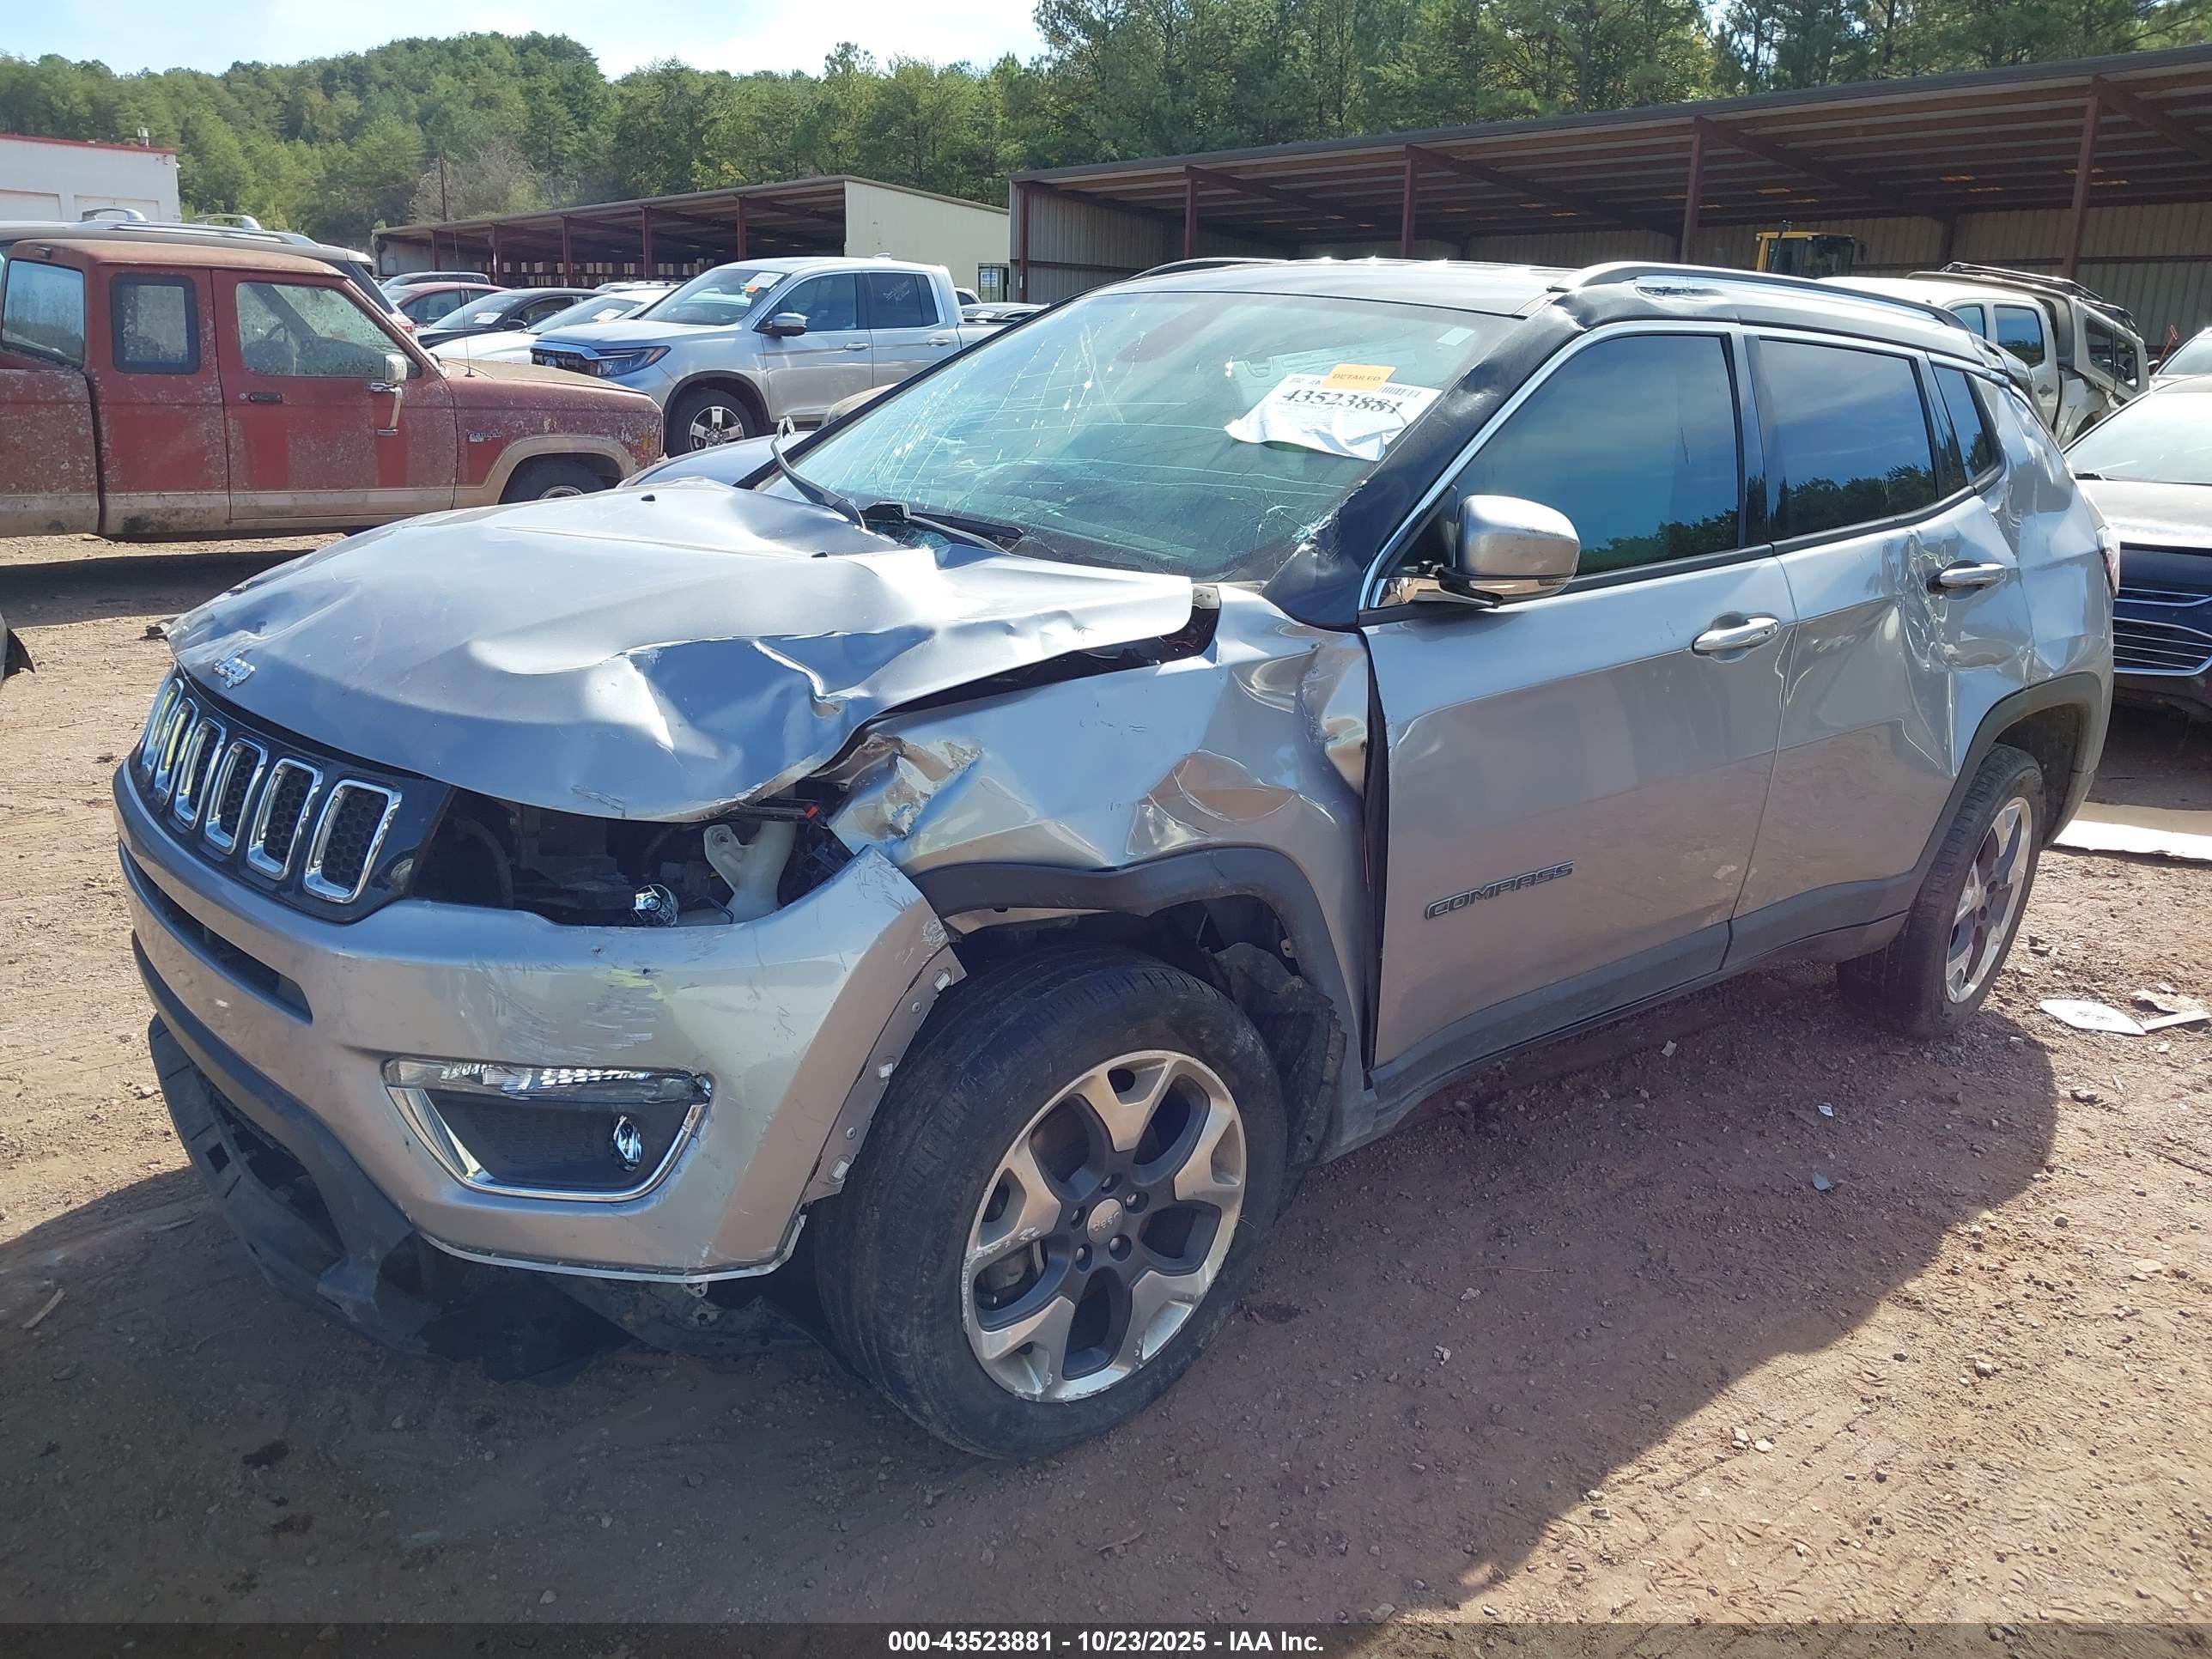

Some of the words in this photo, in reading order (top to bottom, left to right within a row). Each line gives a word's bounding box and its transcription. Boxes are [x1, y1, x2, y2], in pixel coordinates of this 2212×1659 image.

[1332, 374, 1381, 382] DETAILED
[1282, 389, 1404, 414] 43523881
[1424, 860, 1574, 920] COMPASS
